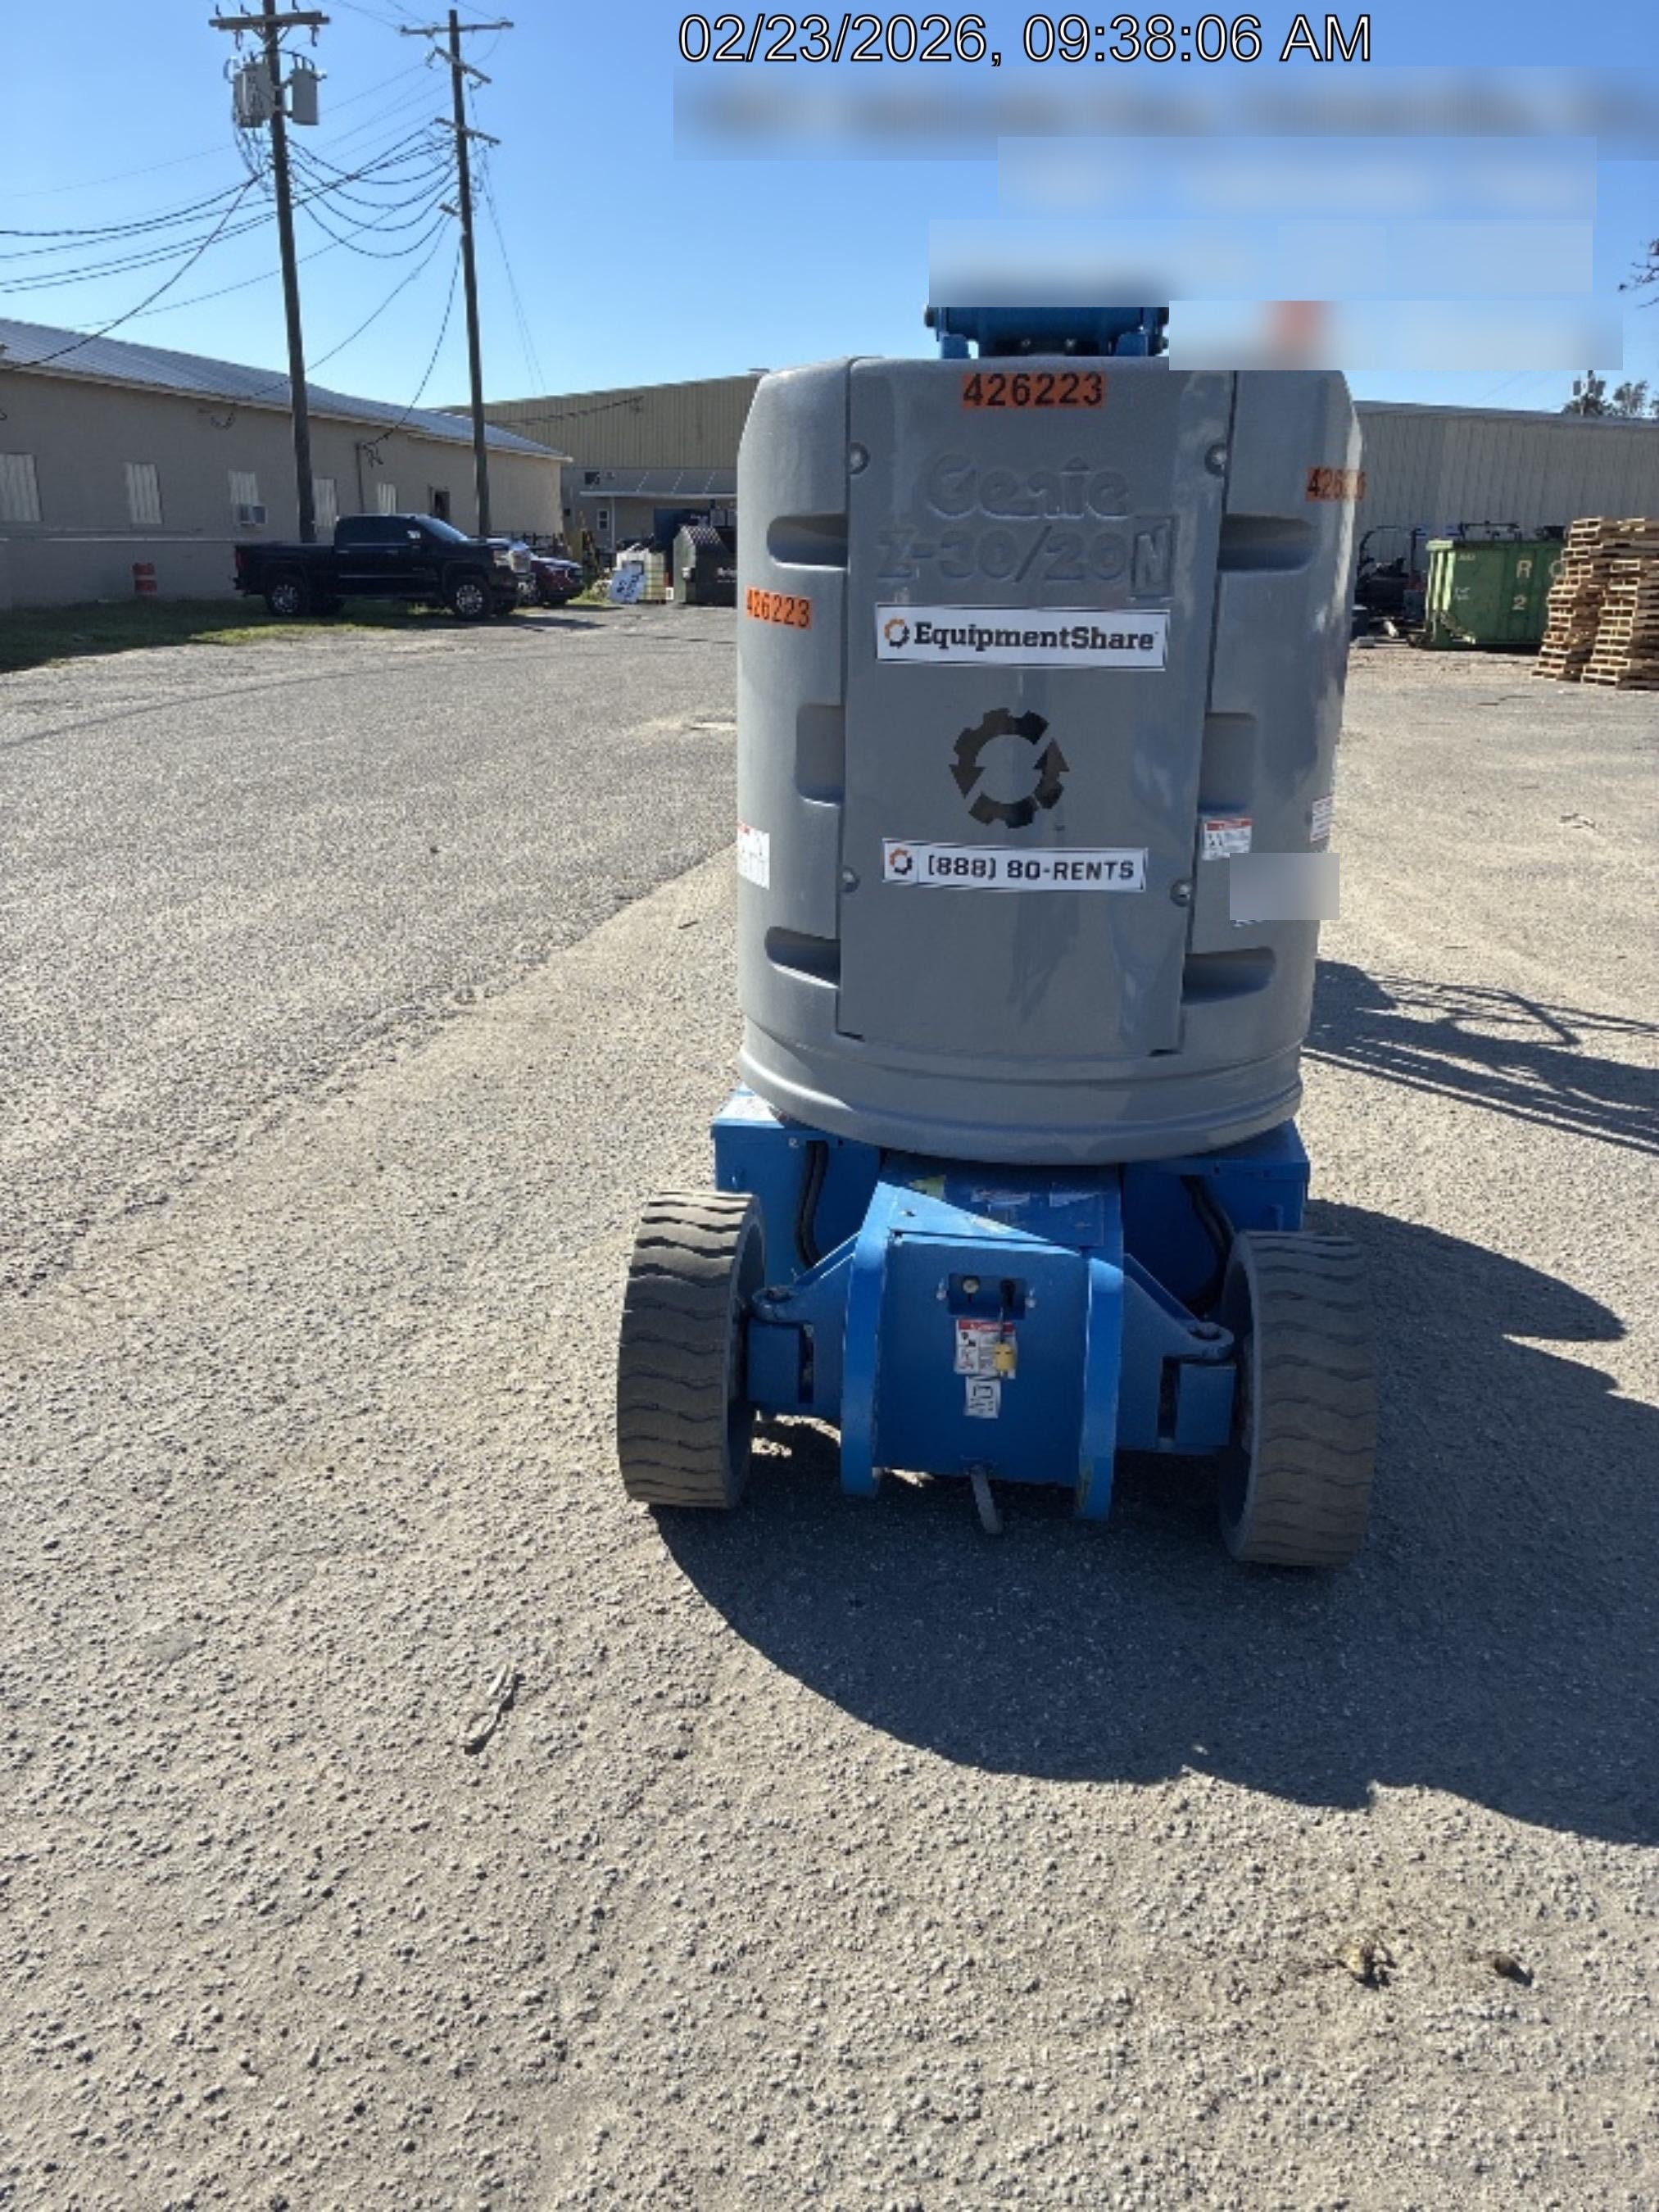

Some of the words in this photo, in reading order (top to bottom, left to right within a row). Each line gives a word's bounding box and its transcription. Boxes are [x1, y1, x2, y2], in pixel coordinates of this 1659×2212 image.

[963, 372, 1103, 406] 426223
[924, 453, 1131, 519] Genie
[746, 589, 809, 628] 426223
[913, 621, 1154, 651] EquipmentShare
[1007, 859, 1135, 881] 80-RENTS
